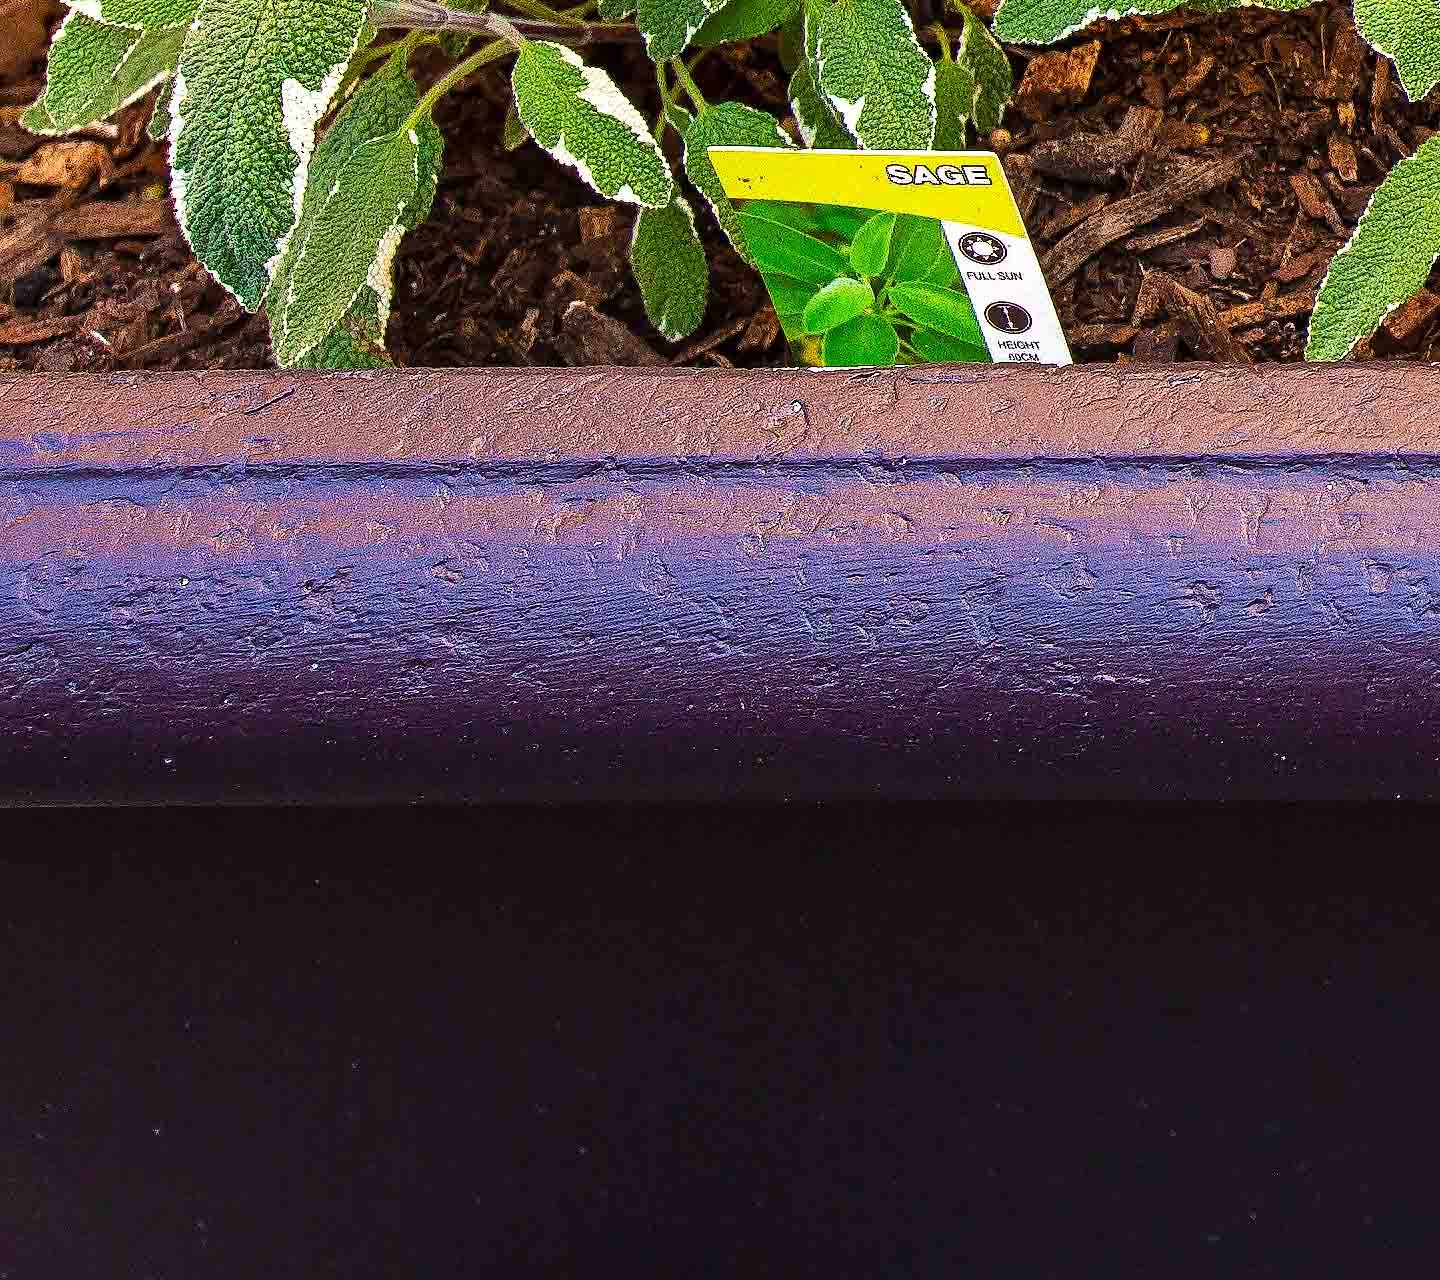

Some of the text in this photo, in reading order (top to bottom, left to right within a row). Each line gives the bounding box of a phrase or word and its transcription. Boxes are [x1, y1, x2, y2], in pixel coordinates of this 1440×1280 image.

[886, 164, 992, 185] SAGE
[966, 271, 1024, 280] FULL SUN
[998, 339, 1040, 350] HEIGHT
